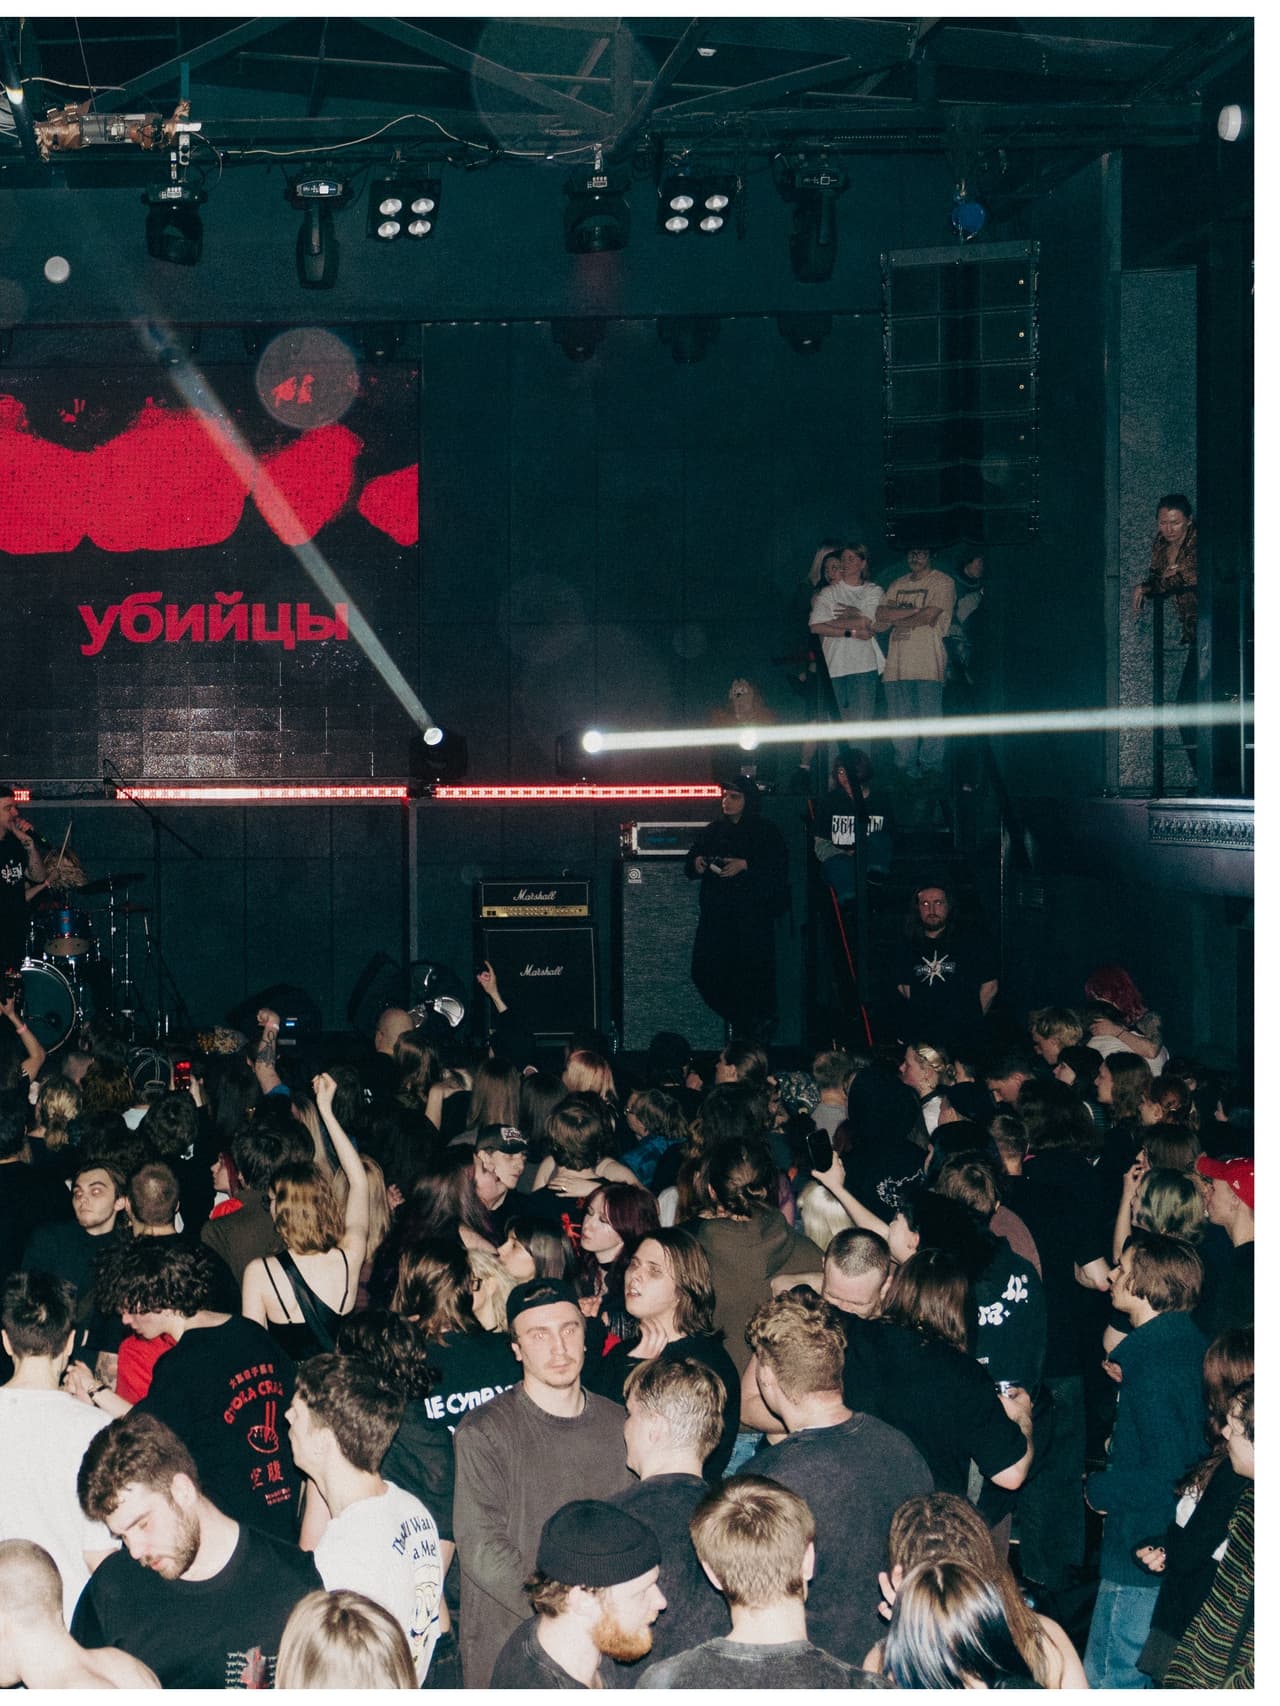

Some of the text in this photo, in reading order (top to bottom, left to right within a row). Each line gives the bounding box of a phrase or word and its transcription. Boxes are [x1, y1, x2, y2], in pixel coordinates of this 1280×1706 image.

[77, 591, 349, 656] убийцы
[512, 888, 557, 901] Marshall
[520, 964, 564, 977] Marshall
